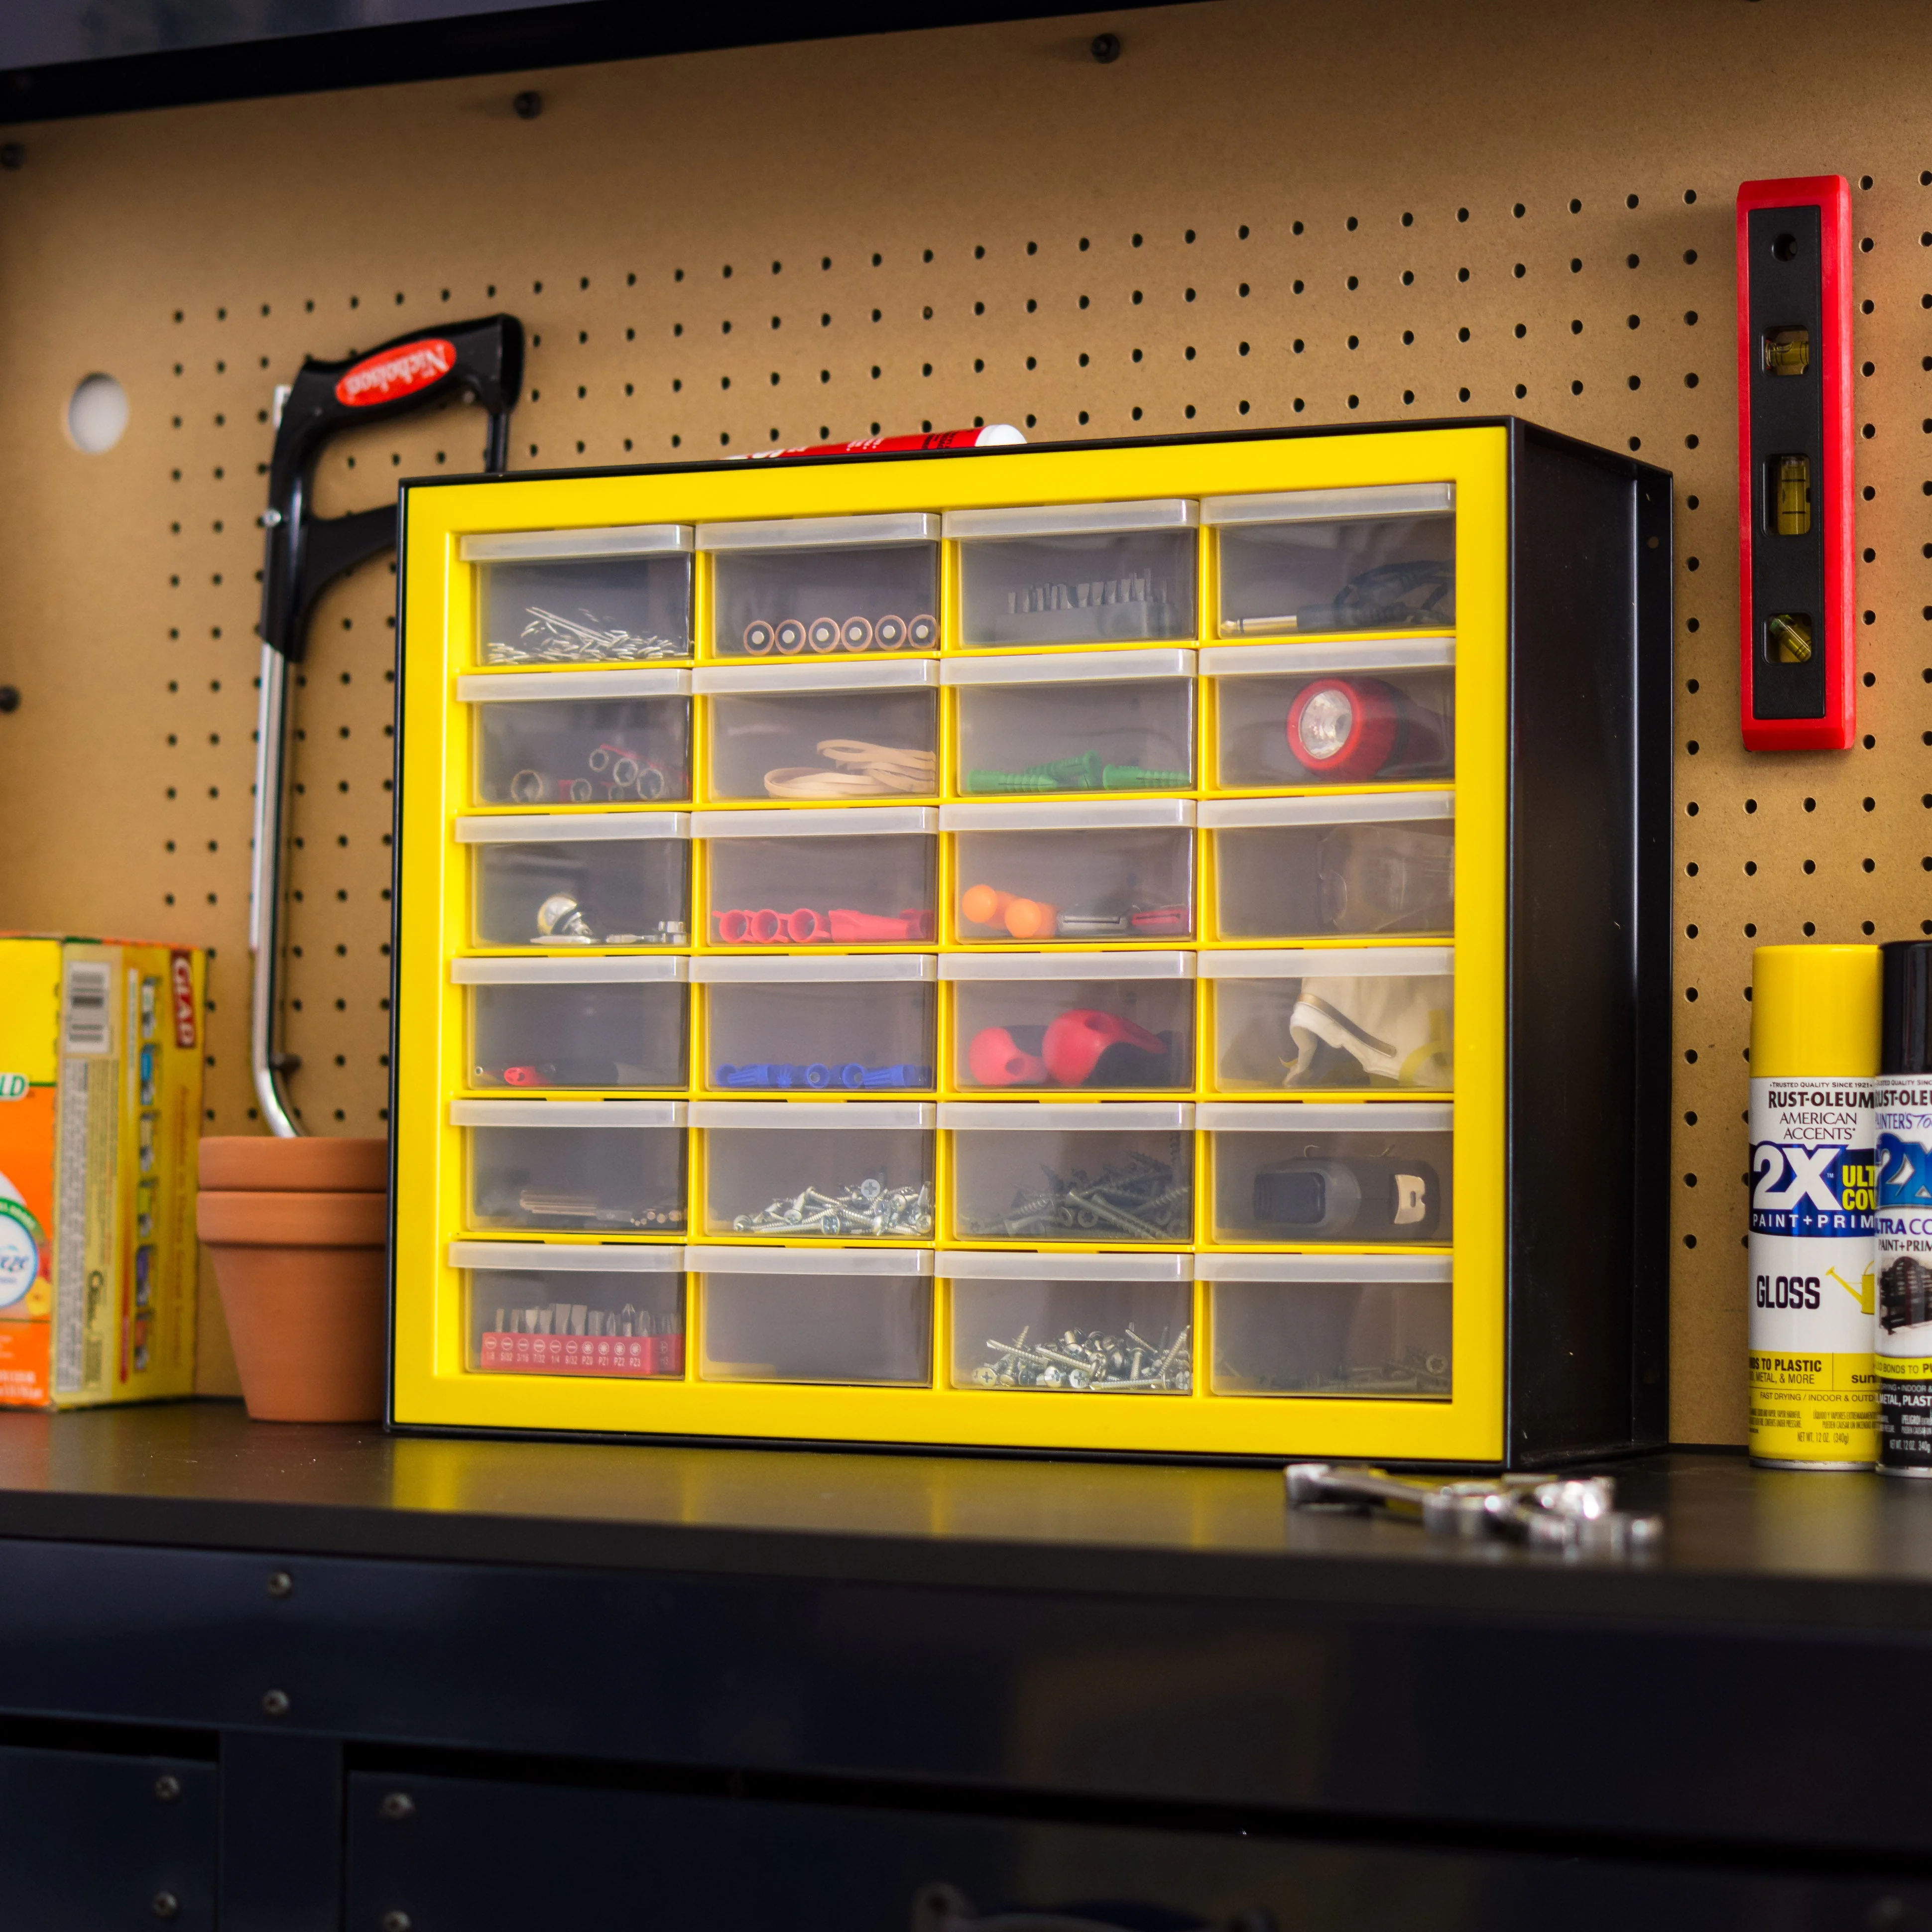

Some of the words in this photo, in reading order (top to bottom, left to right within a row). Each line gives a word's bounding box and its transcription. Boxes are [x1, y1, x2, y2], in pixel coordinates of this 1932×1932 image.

[172, 957, 195, 1045] GLAD
[1768, 1090, 1874, 1108] RUST-OLEUM
[1780, 1112, 1857, 1125] AMERICAN
[1783, 1127, 1853, 1140] ACCENTS
[1753, 1144, 1843, 1210] 2X
[1757, 1275, 1820, 1310] GLOSS
[533, 1353, 545, 1363] 7/32
[599, 1357, 609, 1366] PZ1
[614, 1357, 625, 1367] PZ2
[629, 1357, 641, 1367] PZ3
[1761, 1358, 1772, 1370] TO
[1775, 1359, 1821, 1372] PLASTIC
[1883, 1363, 1905, 1373] BONDS
[1908, 1365, 1919, 1373] TO
[1756, 1372, 1777, 1385] METAL,
[1780, 1374, 1785, 1383] &
[1788, 1374, 1815, 1384] MORE
[1851, 1374, 1875, 1383] sun
[1760, 1392, 1773, 1400] FAST
[1774, 1393, 1801, 1401] DRYING
[1816, 1432, 1821, 1443] 12
[1833, 1432, 1849, 1445] (340g)
